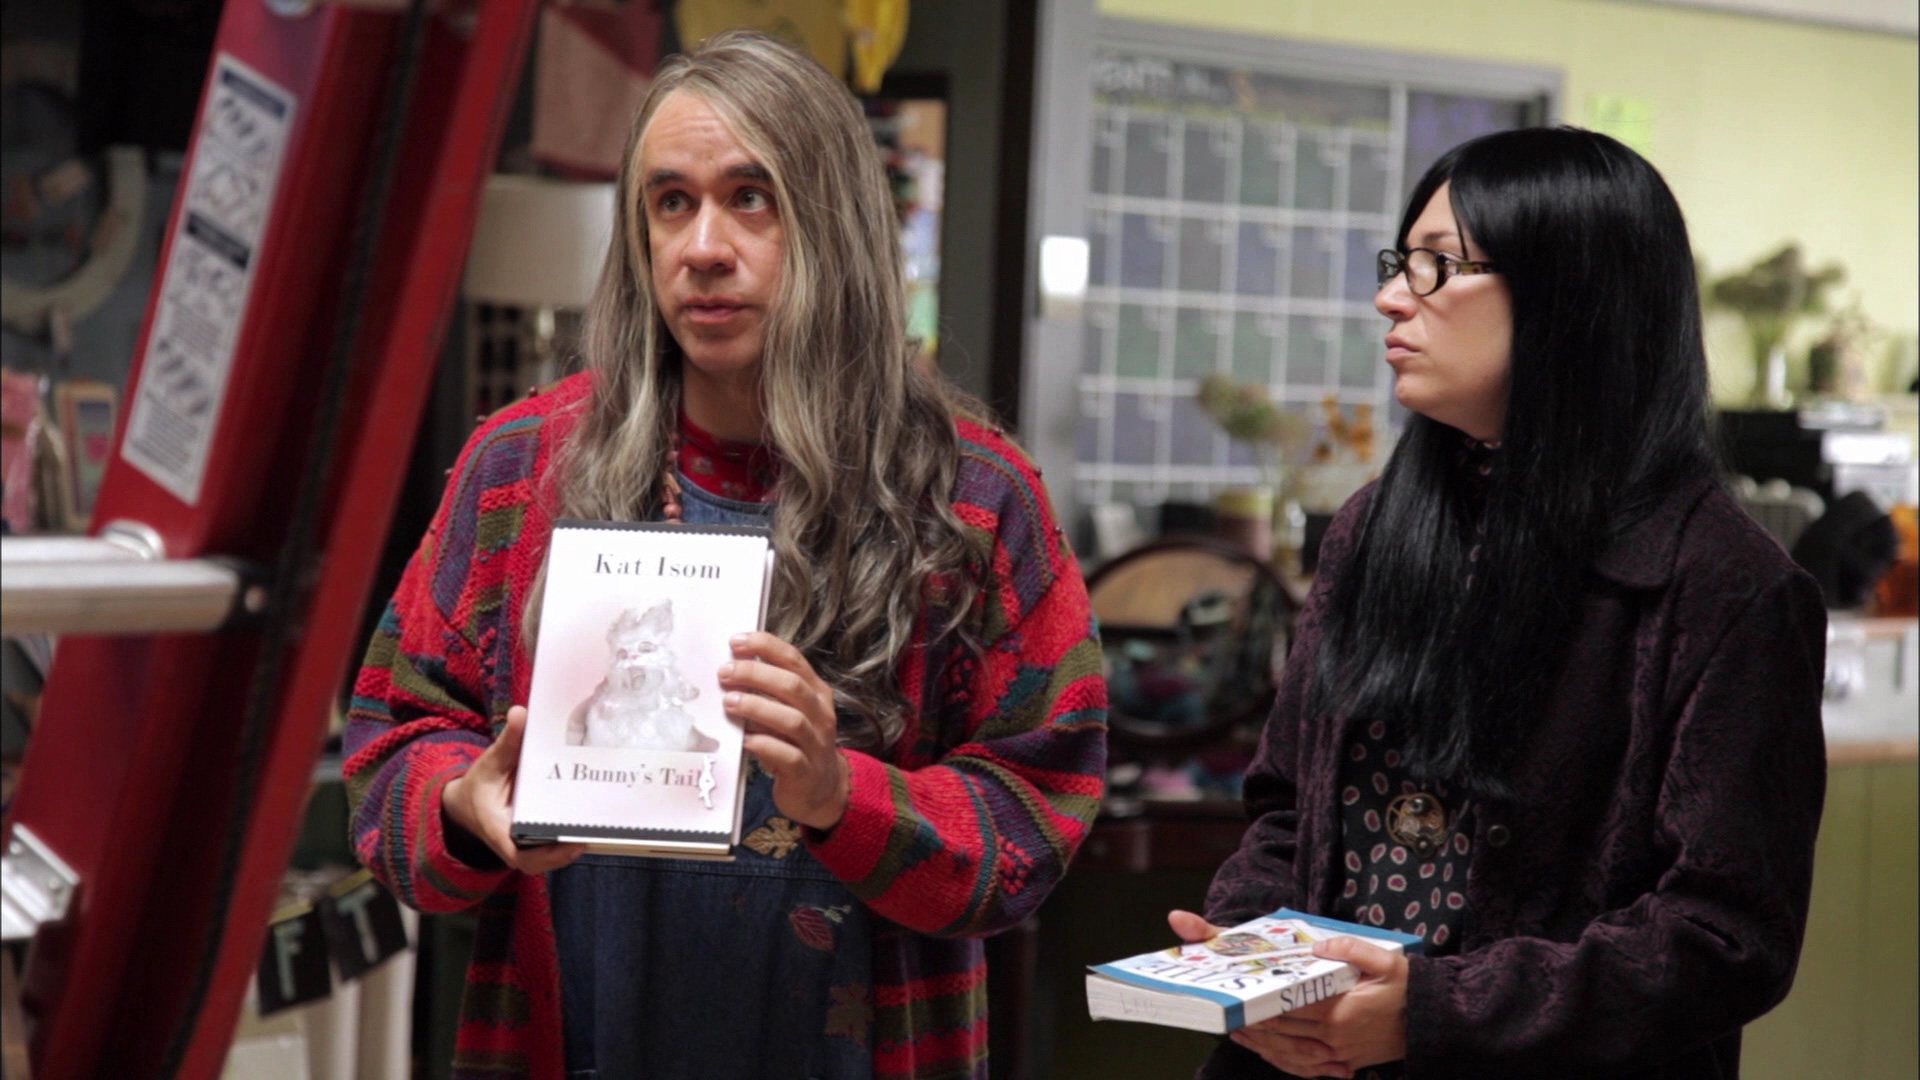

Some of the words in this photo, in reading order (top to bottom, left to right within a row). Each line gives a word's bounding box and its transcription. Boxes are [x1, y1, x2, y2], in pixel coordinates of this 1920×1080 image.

[594, 552, 642, 576] Kat
[657, 555, 722, 580] Isom
[547, 762, 562, 781] A
[572, 762, 653, 788] Bunny's
[1280, 973, 1338, 1013] S/HE
